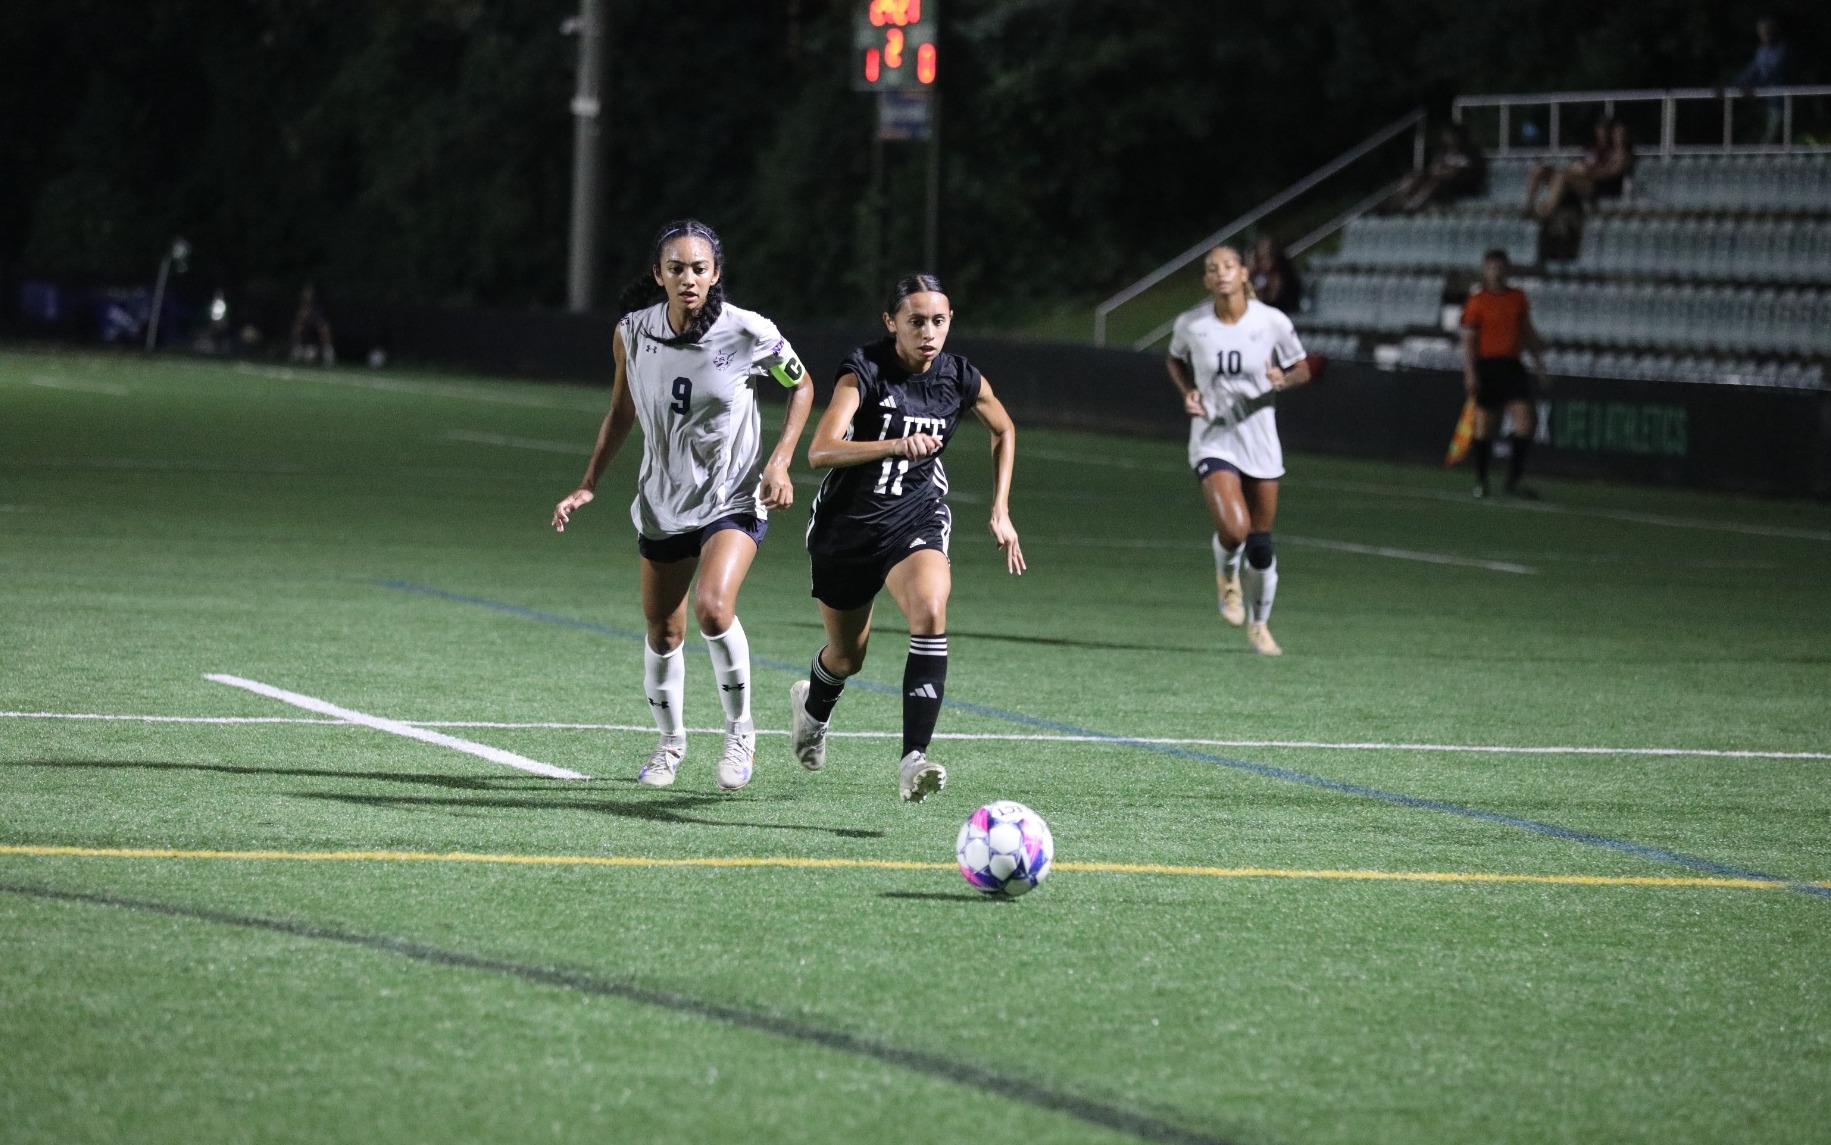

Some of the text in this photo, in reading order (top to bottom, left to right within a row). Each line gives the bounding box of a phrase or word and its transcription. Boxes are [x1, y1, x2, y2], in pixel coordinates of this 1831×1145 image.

[866, 48, 880, 82] 1
[885, 28, 904, 68] 2
[784, 357, 803, 381] C
[1217, 350, 1241, 375] 10
[671, 376, 693, 415] 9
[873, 458, 909, 496] 11
